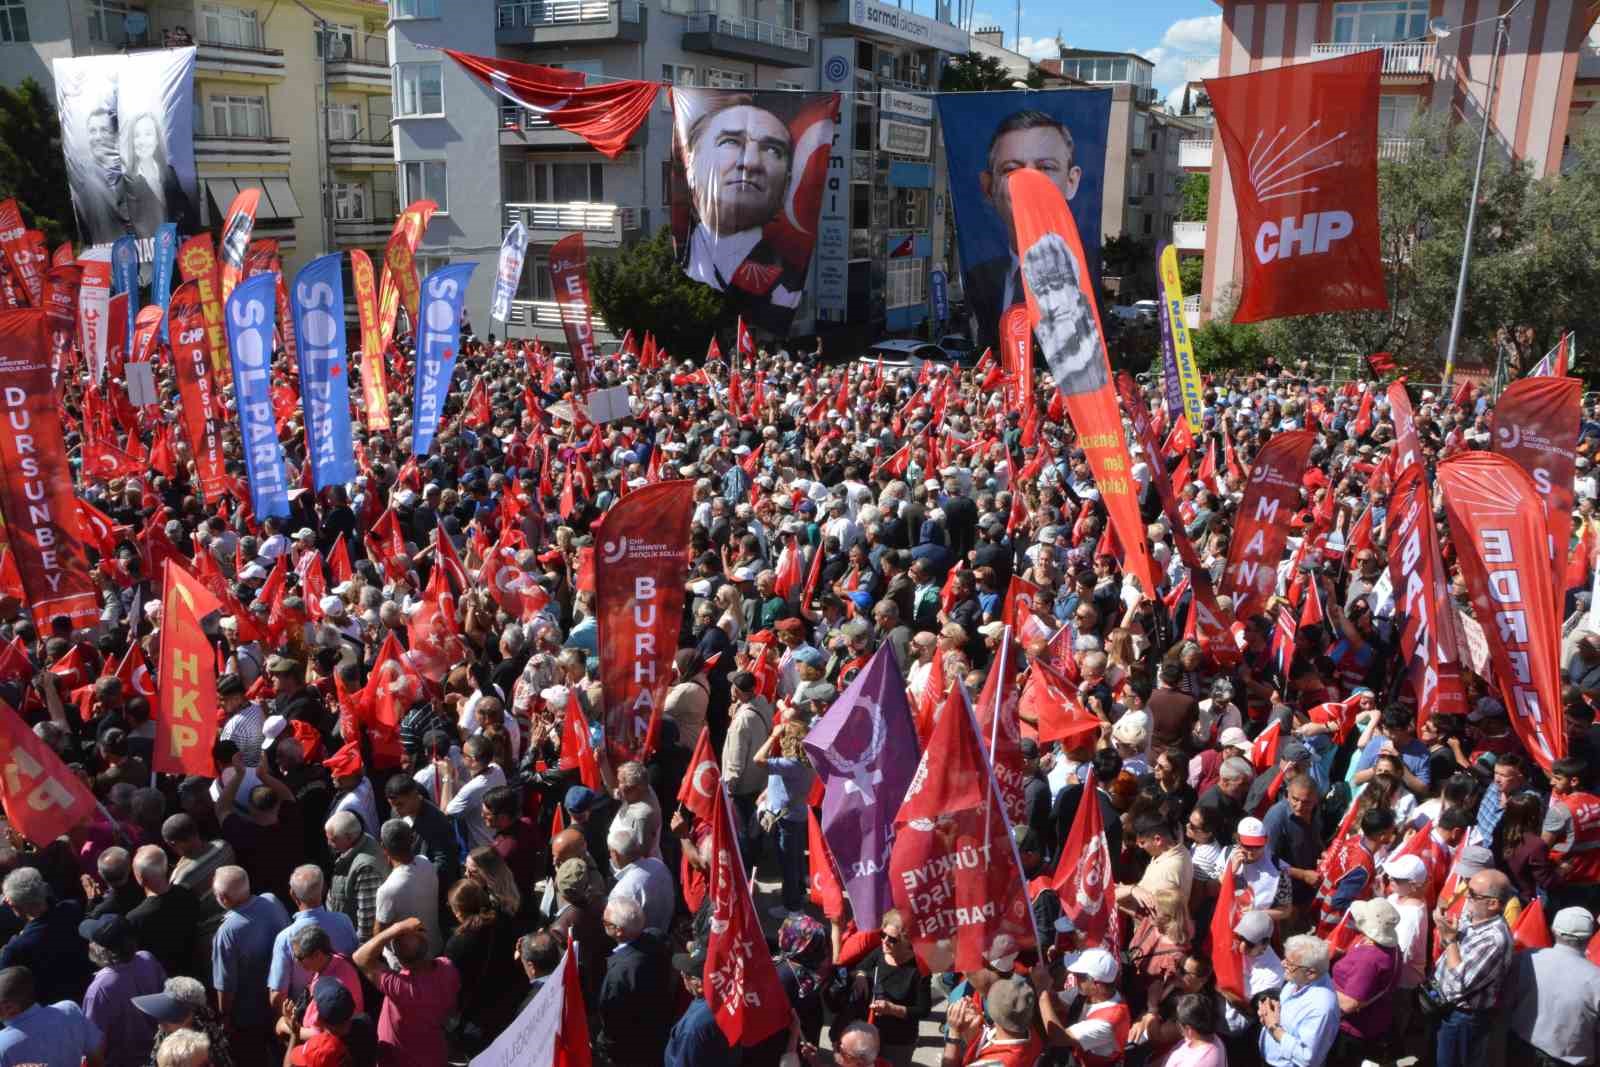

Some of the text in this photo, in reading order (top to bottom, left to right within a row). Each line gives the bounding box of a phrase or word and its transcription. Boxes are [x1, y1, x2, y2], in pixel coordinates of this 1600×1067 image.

[866, 6, 900, 31] sarmal
[1255, 210, 1354, 265] CHP
[180, 328, 204, 344] CHP
[423, 277, 457, 359] SOL
[231, 299, 283, 496] SOL PARTİ
[300, 280, 338, 468] SOL PARTİ
[4, 388, 60, 594] DURSUNBEY
[171, 646, 203, 758] HKP
